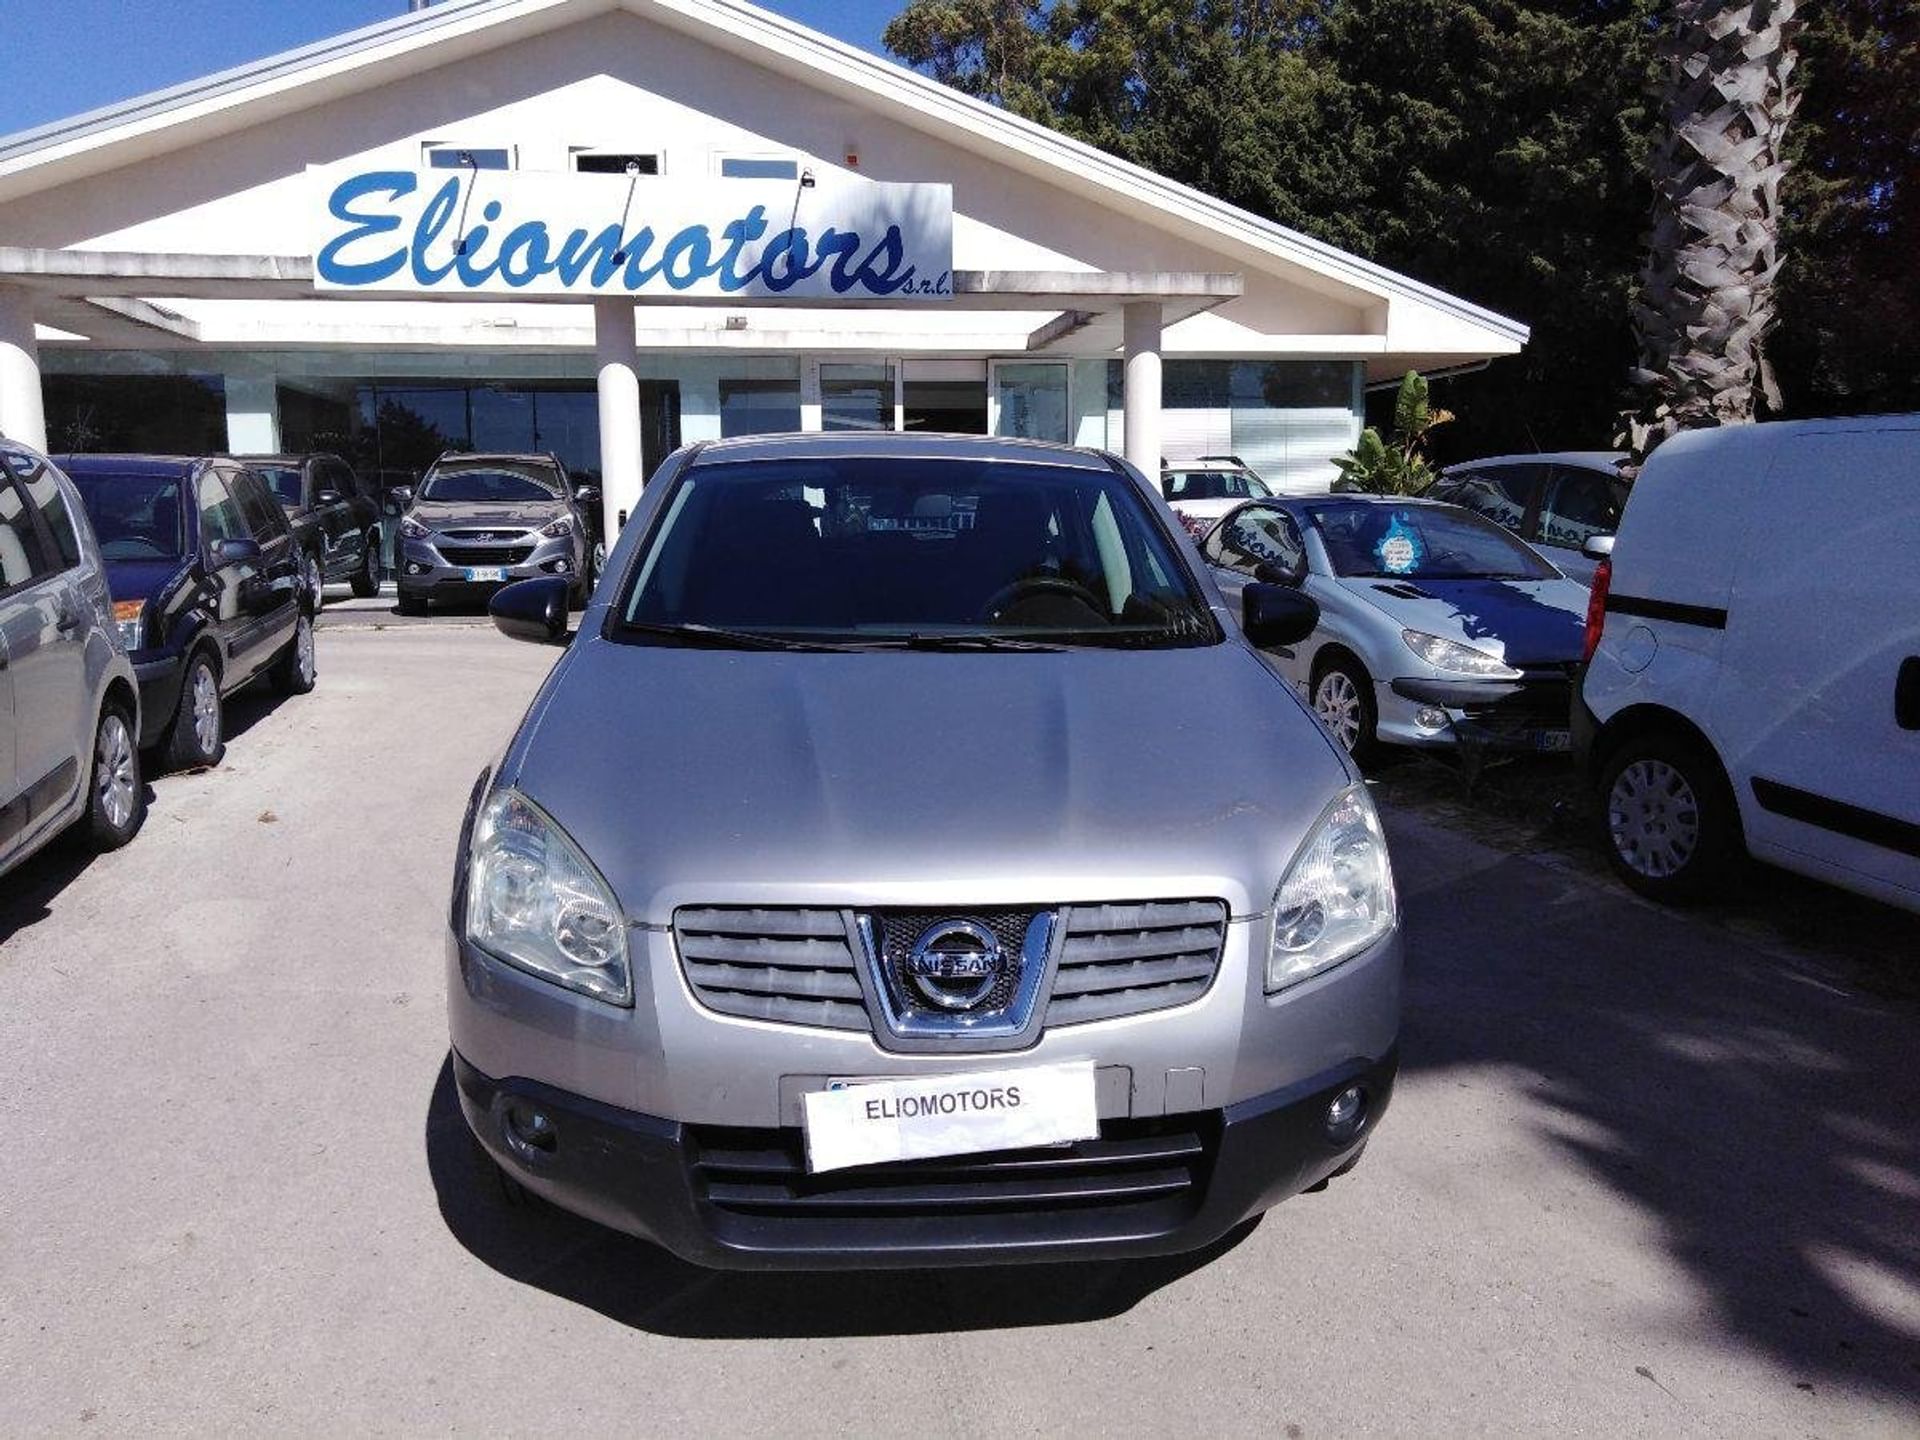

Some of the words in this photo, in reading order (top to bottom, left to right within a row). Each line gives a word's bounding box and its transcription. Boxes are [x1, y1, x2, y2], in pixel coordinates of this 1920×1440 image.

[317, 171, 915, 296] Eliomotors
[901, 271, 950, 295] s.r.l.
[915, 955, 998, 974] NISSAN
[866, 1086, 1021, 1120] ELIOMOTORS
